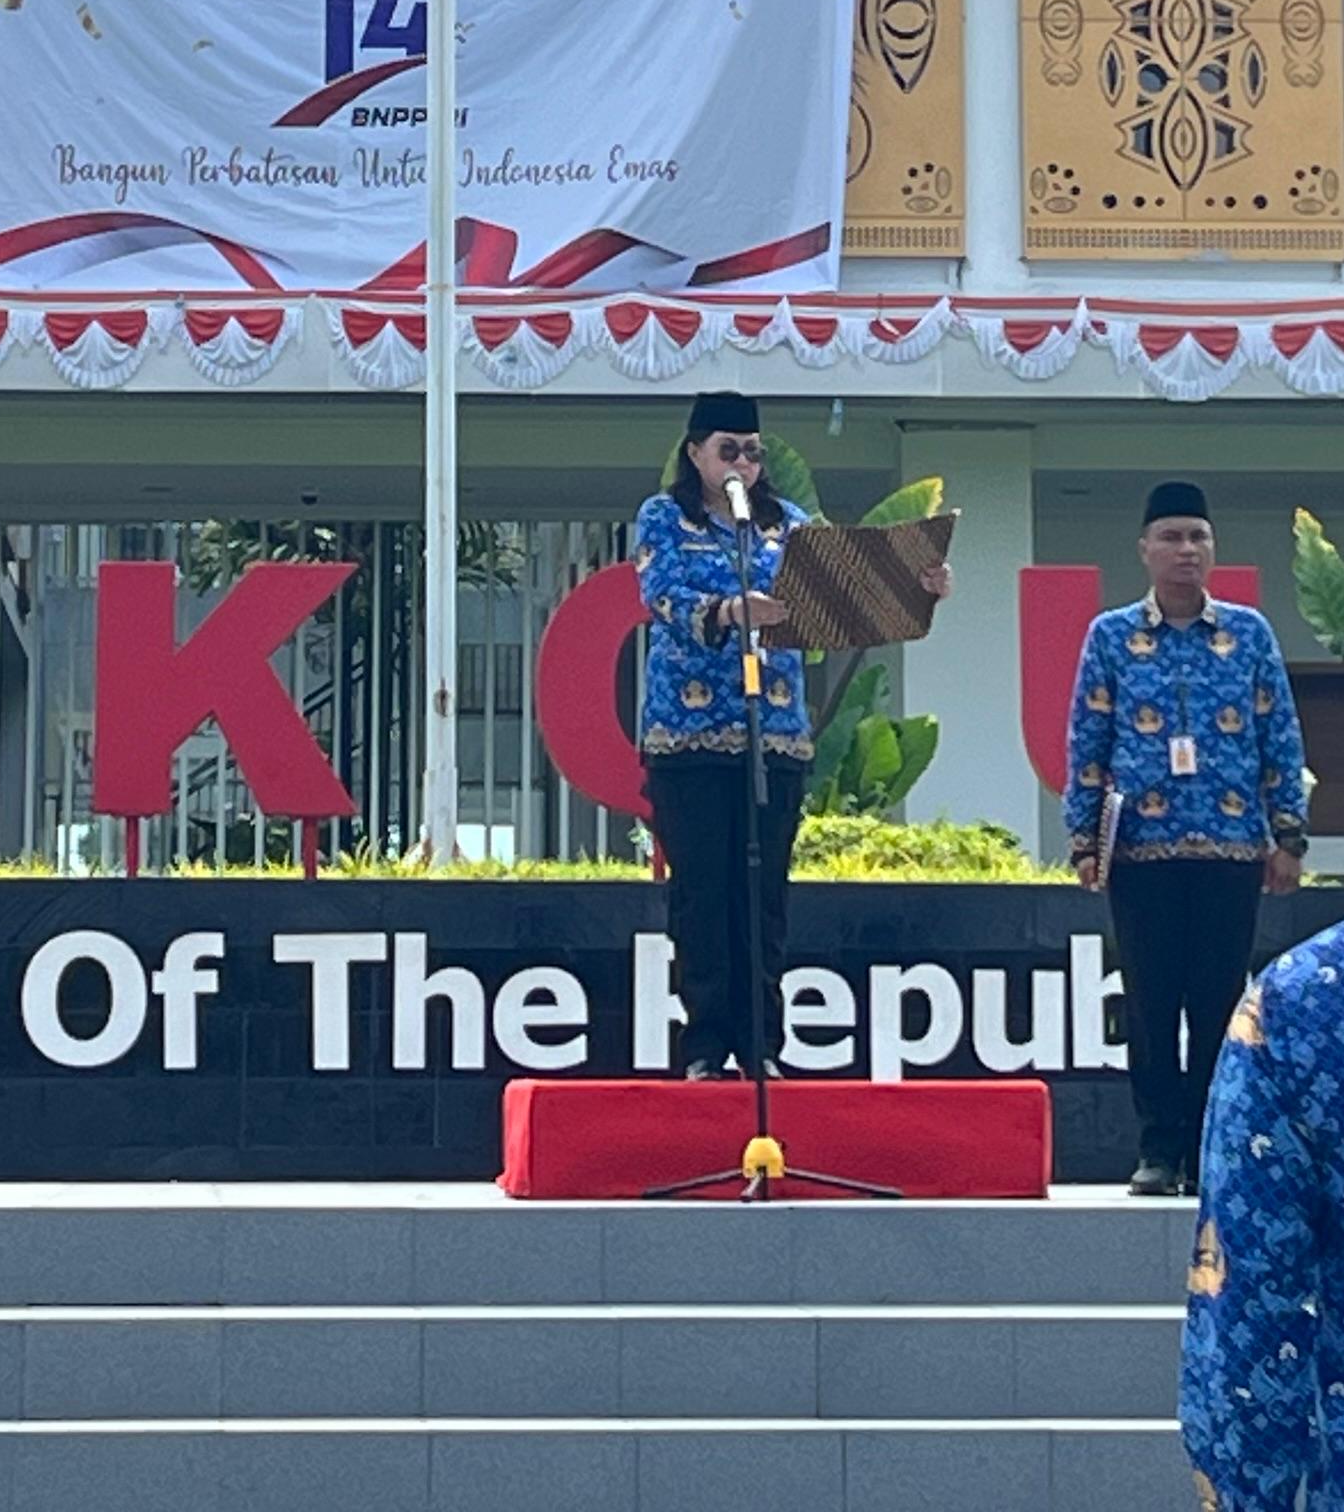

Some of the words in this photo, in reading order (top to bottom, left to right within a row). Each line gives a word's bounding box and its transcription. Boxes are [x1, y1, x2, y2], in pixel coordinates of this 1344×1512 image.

[351, 107, 427, 128] BNPP
[51, 143, 172, 206] Bangun
[181, 145, 343, 189] Perbatasan
[353, 146, 427, 189] Untu
[458, 146, 598, 187] Indonesia
[606, 143, 681, 184] Emas
[21, 930, 224, 1070] Of
[273, 932, 588, 1070] The
